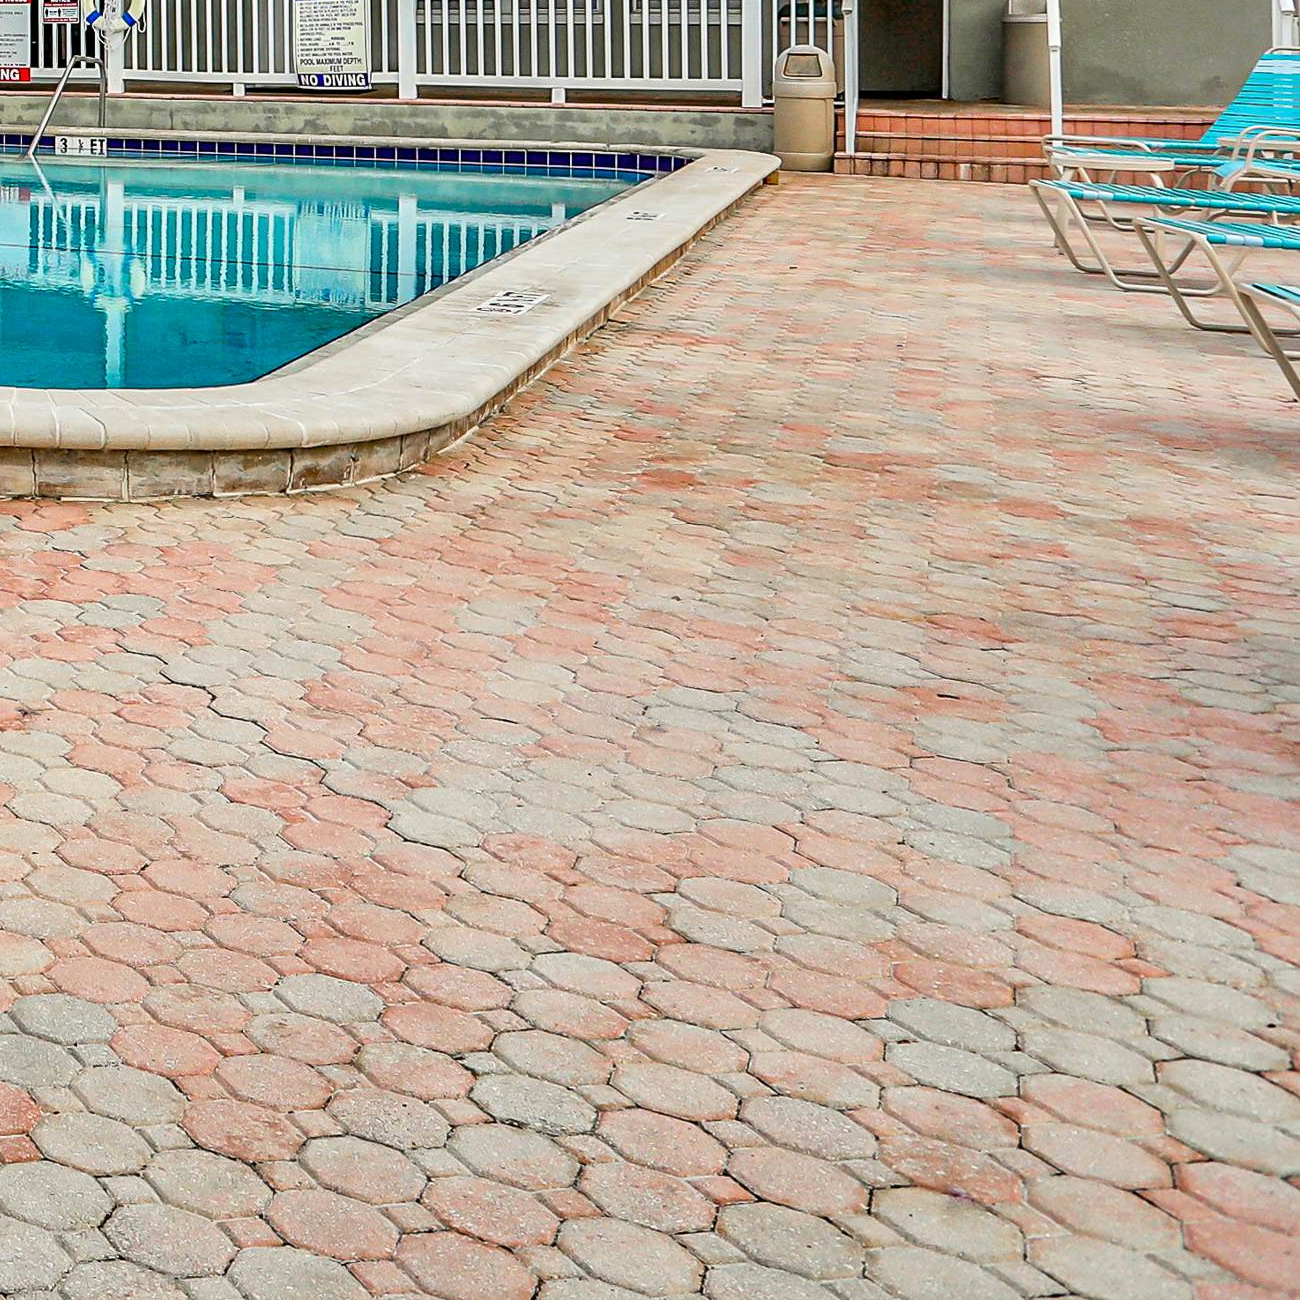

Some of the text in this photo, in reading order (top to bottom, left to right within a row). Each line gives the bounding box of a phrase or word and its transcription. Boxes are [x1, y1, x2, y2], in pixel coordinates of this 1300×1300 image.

[300, 58, 315, 66] POOL
[316, 58, 342, 66] MAXIMUM
[300, 73, 366, 87] NO DIVING
